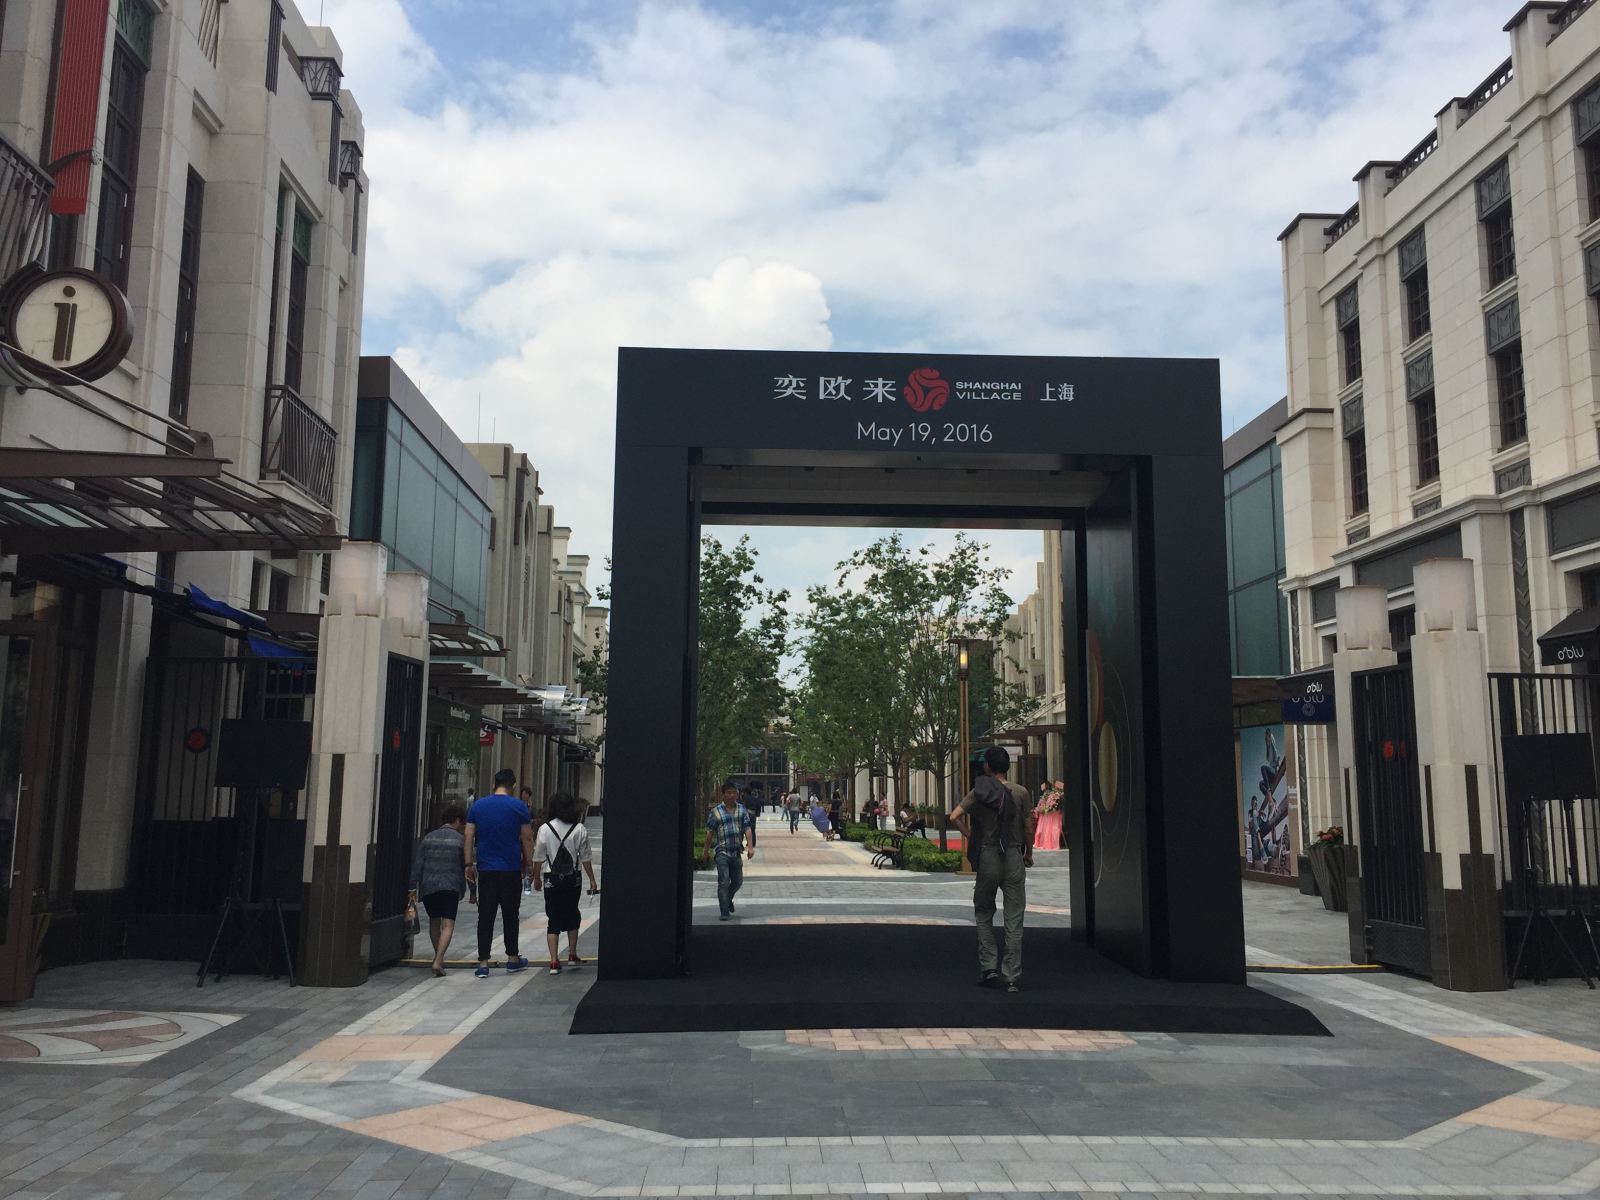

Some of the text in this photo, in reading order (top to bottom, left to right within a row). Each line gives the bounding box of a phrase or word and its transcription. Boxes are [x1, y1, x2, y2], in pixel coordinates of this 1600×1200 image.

[773, 374, 897, 403] 奕欧来
[955, 381, 1022, 390] SHANGHAI
[955, 391, 1022, 400] VILLAGE
[1039, 382, 1075, 402] 上海
[857, 421, 993, 447] May 19, 2016
